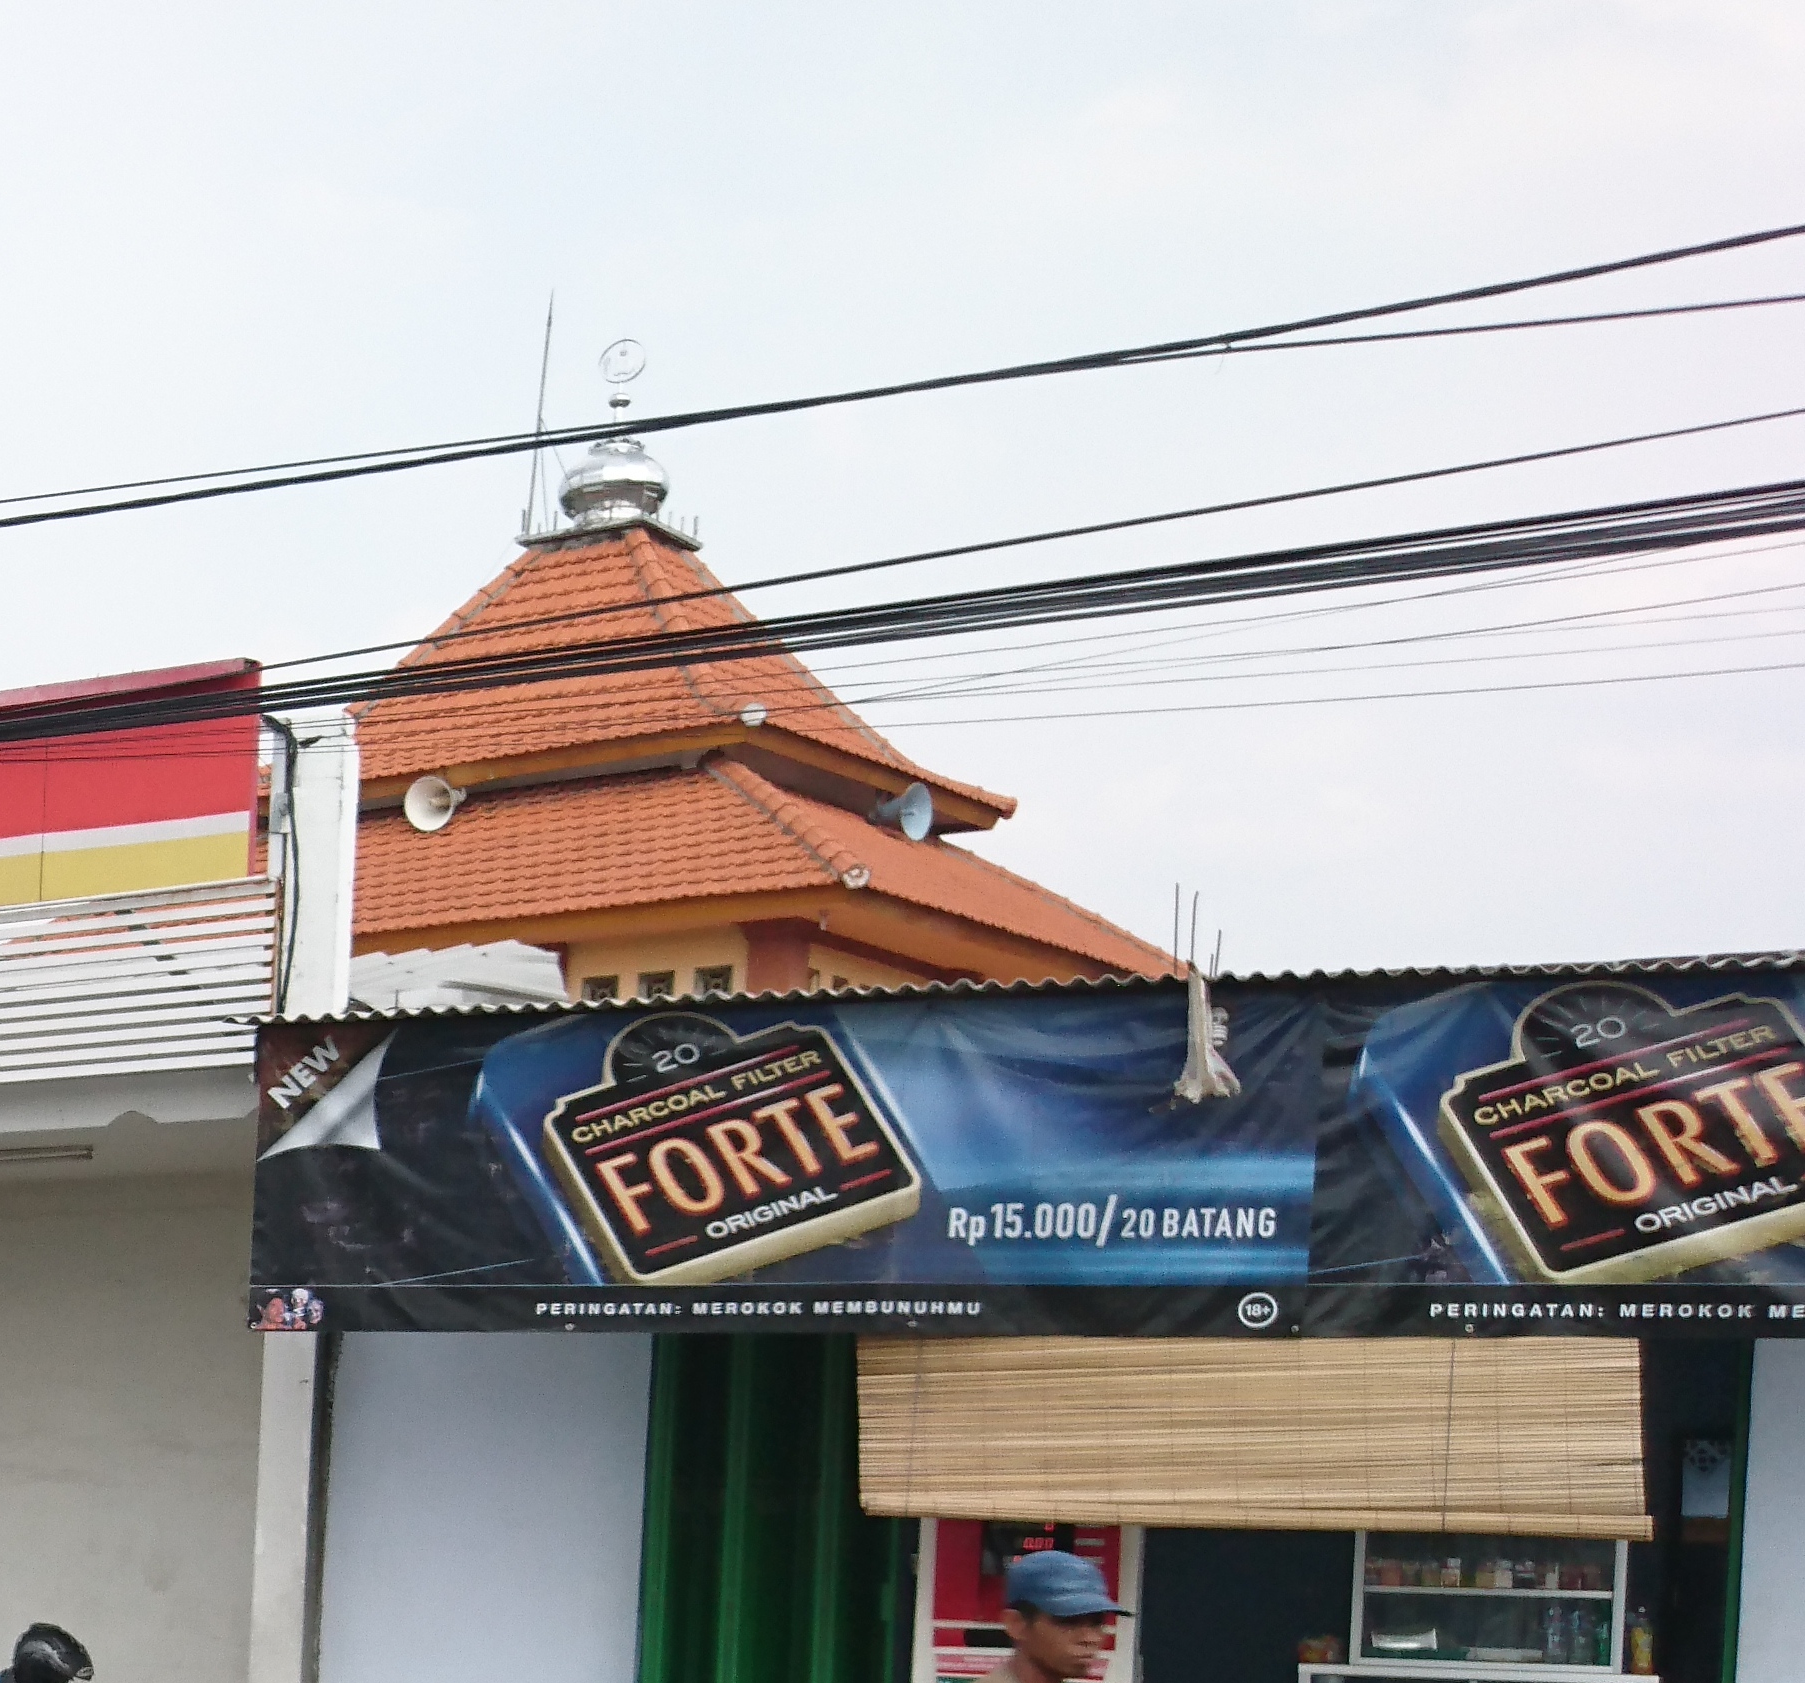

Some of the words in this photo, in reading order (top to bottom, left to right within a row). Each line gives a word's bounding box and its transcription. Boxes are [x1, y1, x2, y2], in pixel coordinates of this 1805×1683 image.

[1573, 1016, 1627, 1049] 20
[266, 1035, 342, 1109] NEW
[650, 1041, 701, 1074] 20
[1473, 1061, 1661, 1126] CHARCOAL
[1666, 1025, 1778, 1069] FILTER
[571, 1082, 727, 1143] CHARCOAL
[730, 1048, 823, 1093] FILTER
[594, 1082, 881, 1238] FORTE
[704, 1184, 839, 1240] ORIGINAL
[1162, 1207, 1278, 1240] BATANG
[1633, 1175, 1799, 1234] ORIGINAL
[535, 1303, 684, 1317] PERINGATAN:
[692, 1301, 804, 1316] MEROKOK
[813, 1300, 983, 1316] MEMBUNUHMU
[1244, 1302, 1271, 1317] 18+
[1430, 1303, 1605, 1318] PERINGATAN:
[1619, 1303, 1753, 1318] MEROKOK
